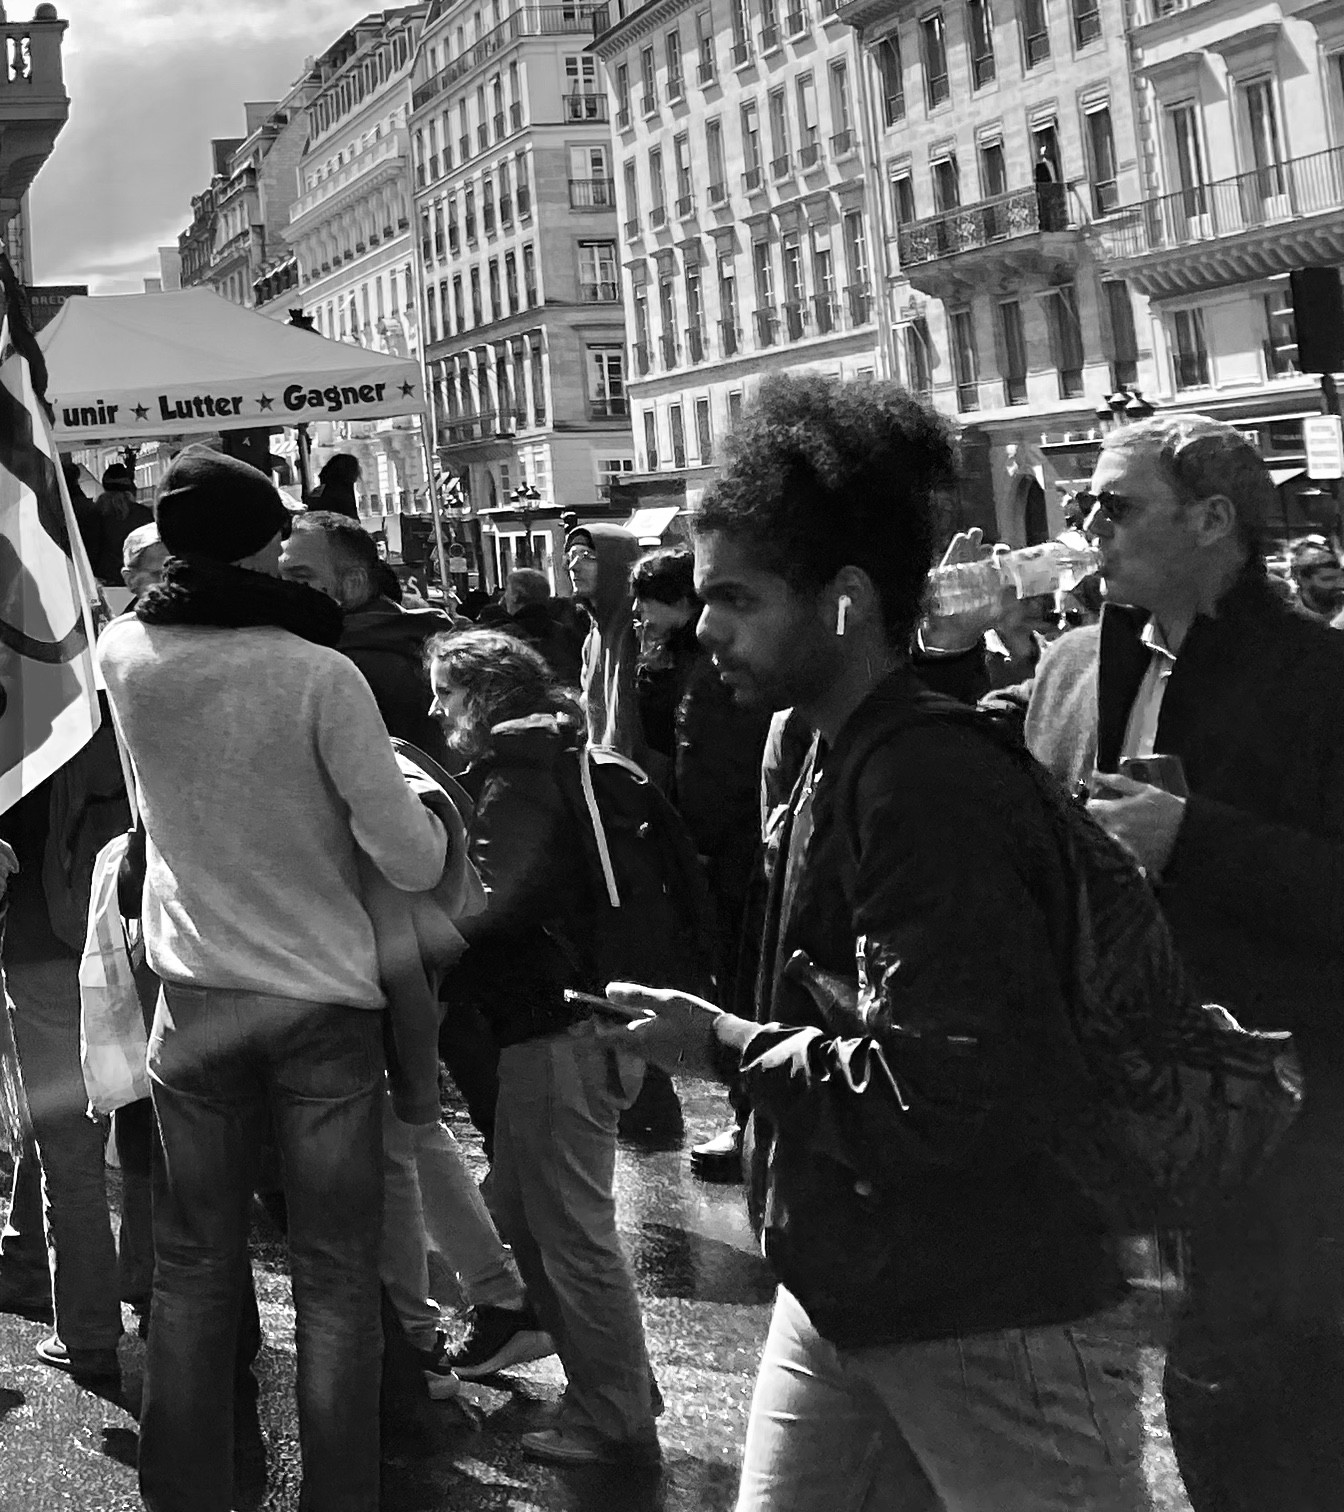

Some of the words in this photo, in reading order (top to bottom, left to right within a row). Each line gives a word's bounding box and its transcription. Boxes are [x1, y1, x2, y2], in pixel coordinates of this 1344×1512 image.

[50, 397, 119, 428] 'unir
[158, 394, 244, 422] Lutter
[283, 382, 387, 412] Gagner
